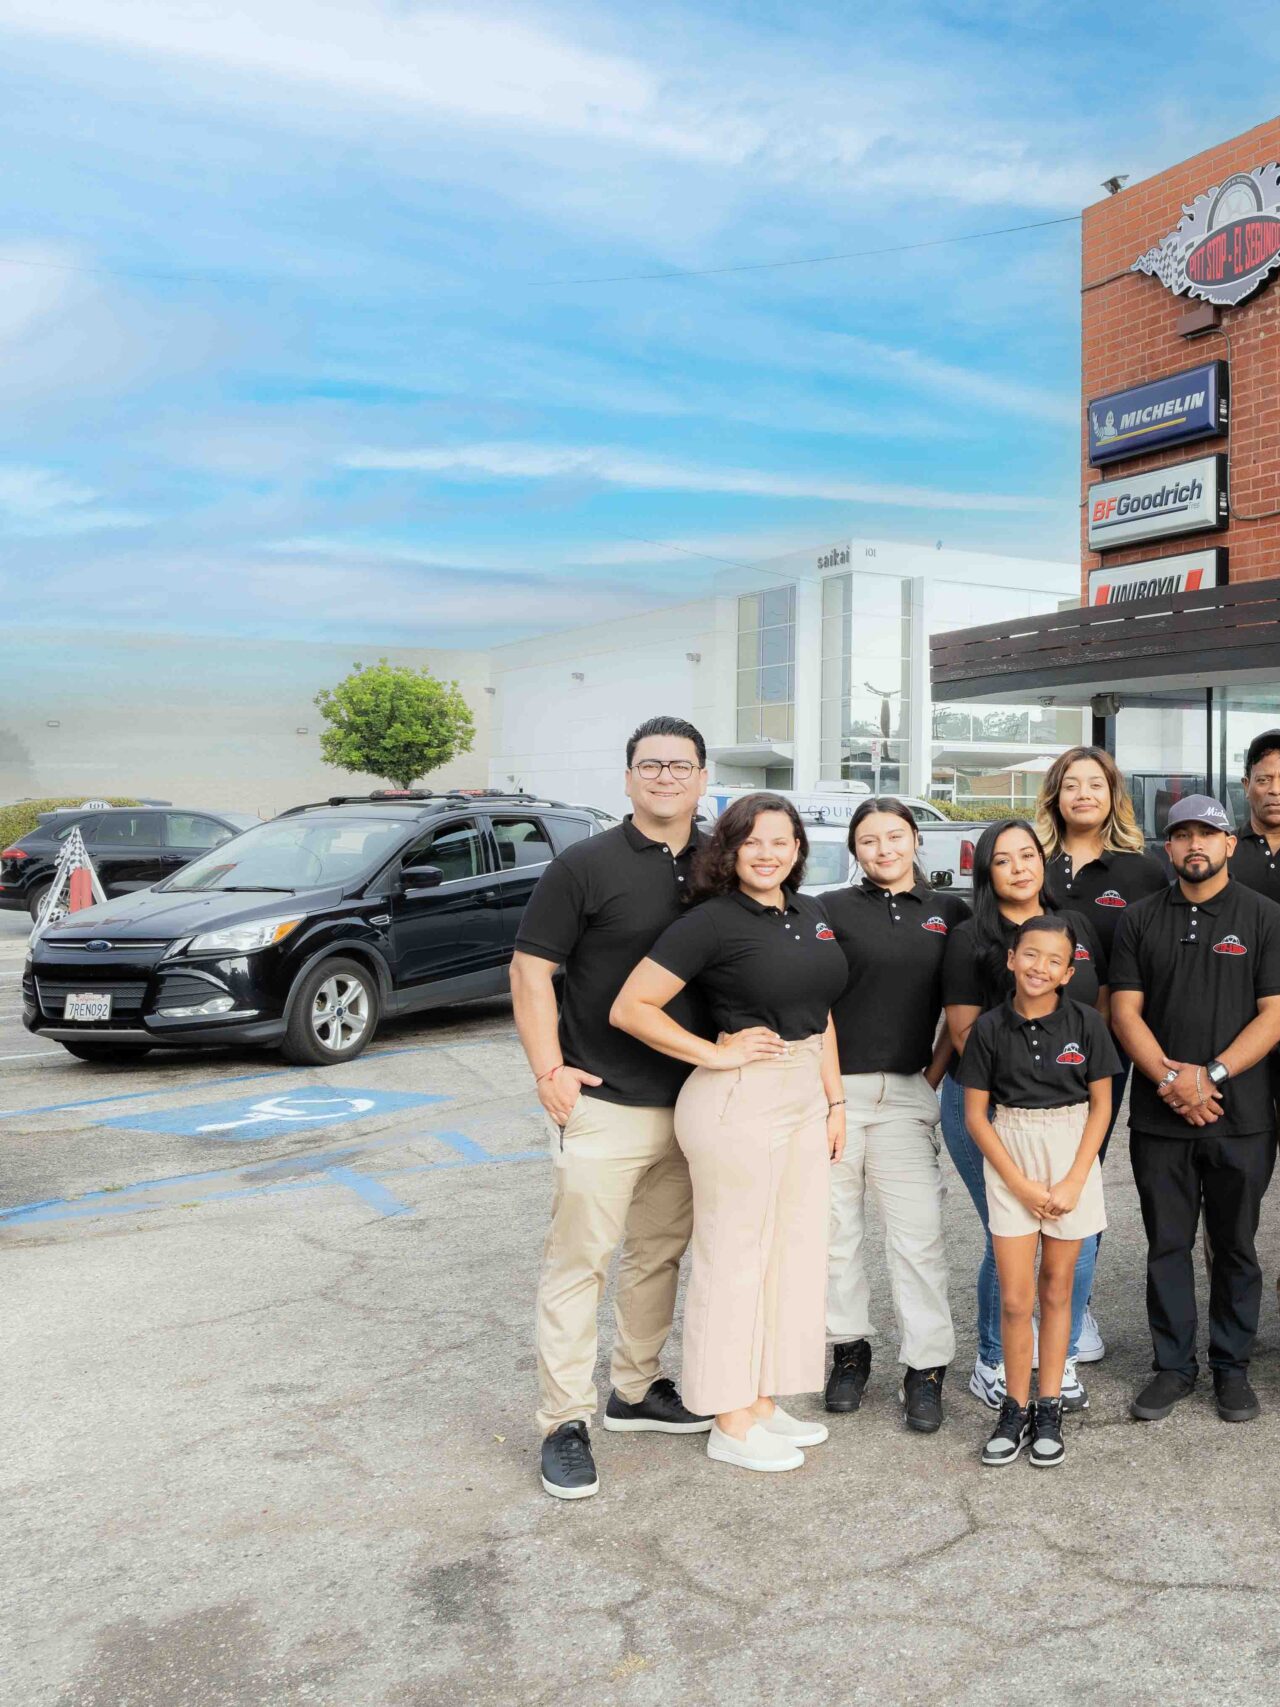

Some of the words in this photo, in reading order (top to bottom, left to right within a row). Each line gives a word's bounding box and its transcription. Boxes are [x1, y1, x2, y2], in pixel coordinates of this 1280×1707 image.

[1206, 232, 1227, 281] STOP
[1233, 226, 1243, 275] EL
[1119, 391, 1206, 430] MICHELIN
[1092, 479, 1203, 522] BFGoodrich
[69, 1003, 109, 1017] 7REN092
